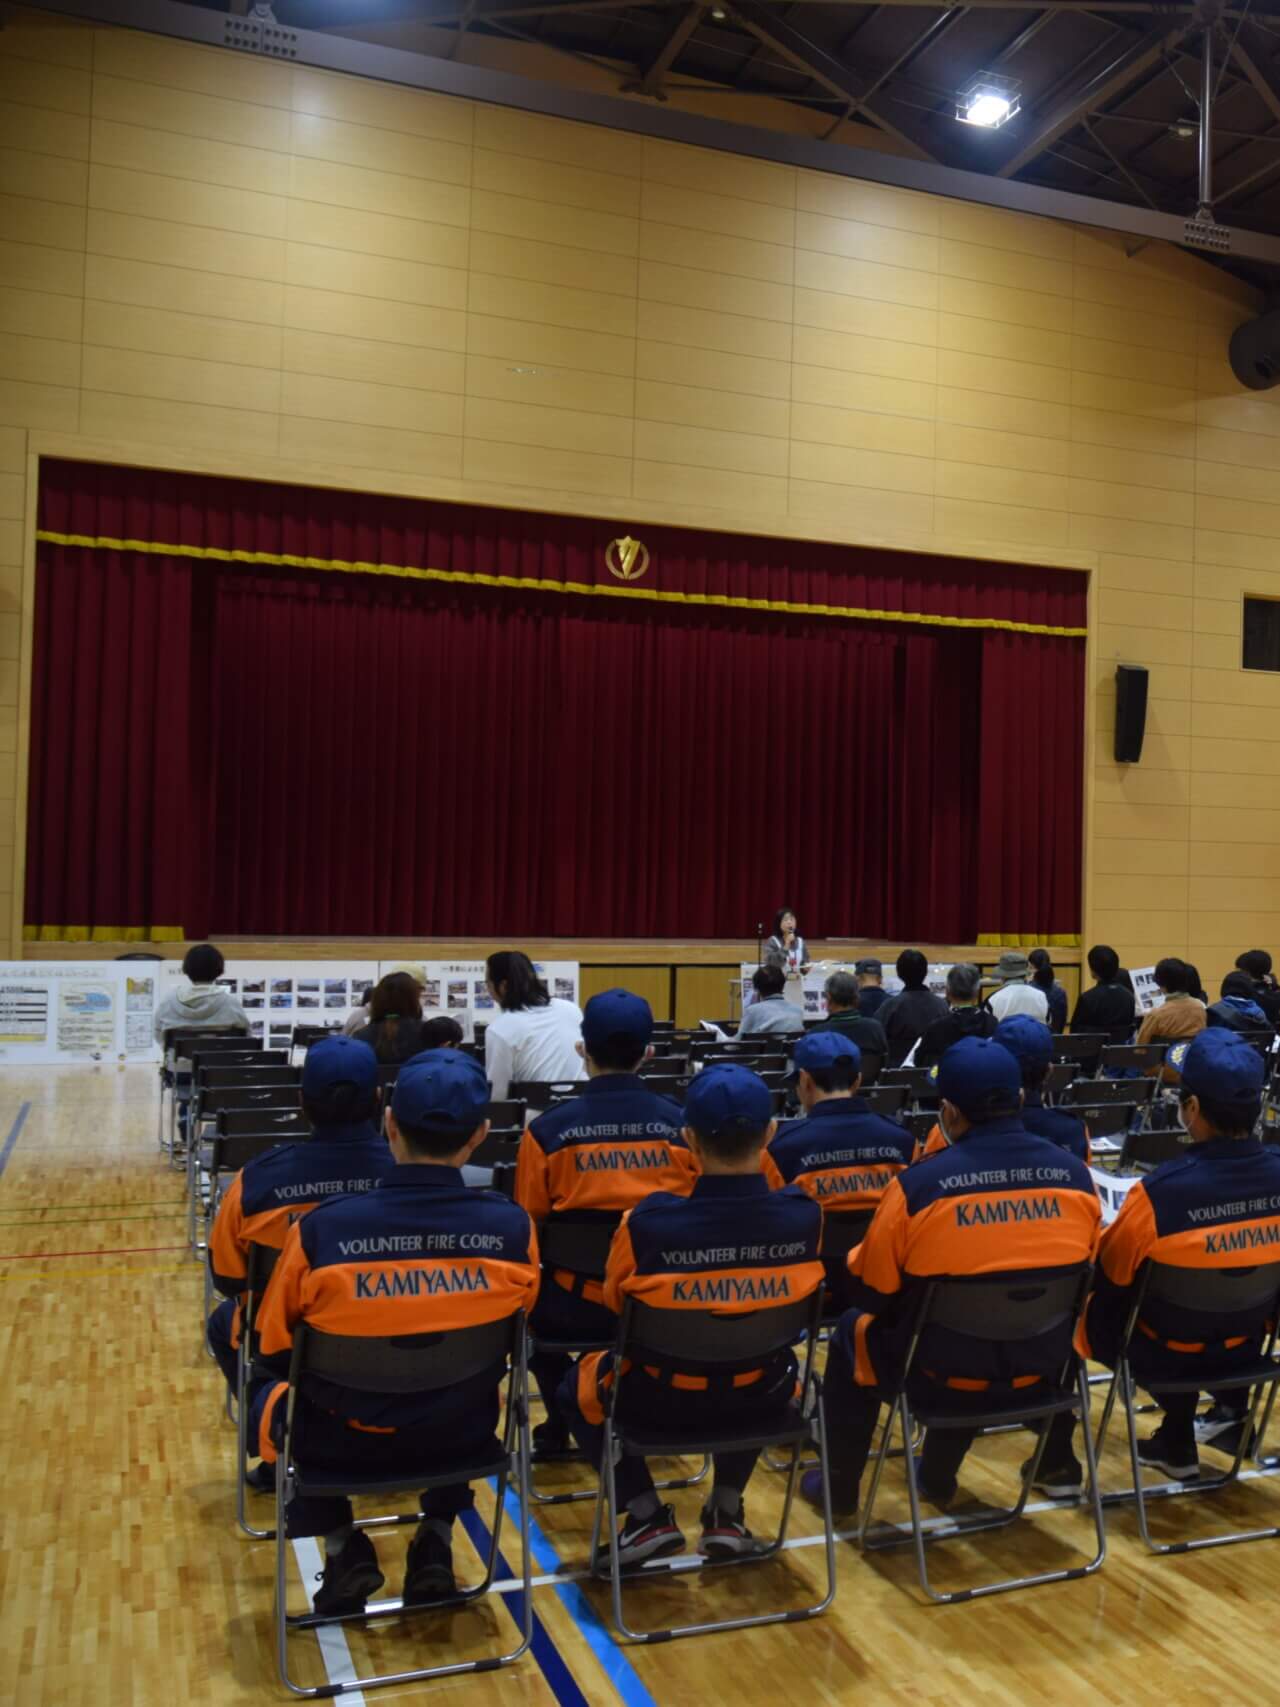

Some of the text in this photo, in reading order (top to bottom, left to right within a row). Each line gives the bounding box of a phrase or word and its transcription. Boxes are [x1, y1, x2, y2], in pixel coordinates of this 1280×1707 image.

[558, 1124, 619, 1141] VOLUNTEER
[621, 1123, 644, 1136] FIRE
[575, 1148, 671, 1172] KAMIYAMA
[800, 1149, 855, 1167] VOLUNTEER
[857, 1147, 877, 1159] FIRE
[274, 1180, 344, 1199] VOLUNTEER
[347, 1178, 371, 1192] FIRE
[815, 1169, 896, 1196] KAMIYAM
[939, 1167, 1072, 1190] VOLUNTEER FIRE CORPS
[956, 1197, 1061, 1227] KAMIYAMA
[1187, 1201, 1247, 1222] VOLUNTEER
[1248, 1197, 1268, 1212] FIRE
[338, 1234, 504, 1255] VOLUNTEER FIRE CORPS
[661, 1240, 807, 1265] VOLUNTEER FIRE CORPS
[355, 1265, 490, 1298] KAMIYAMA
[672, 1273, 790, 1302] KAMIYAMA
